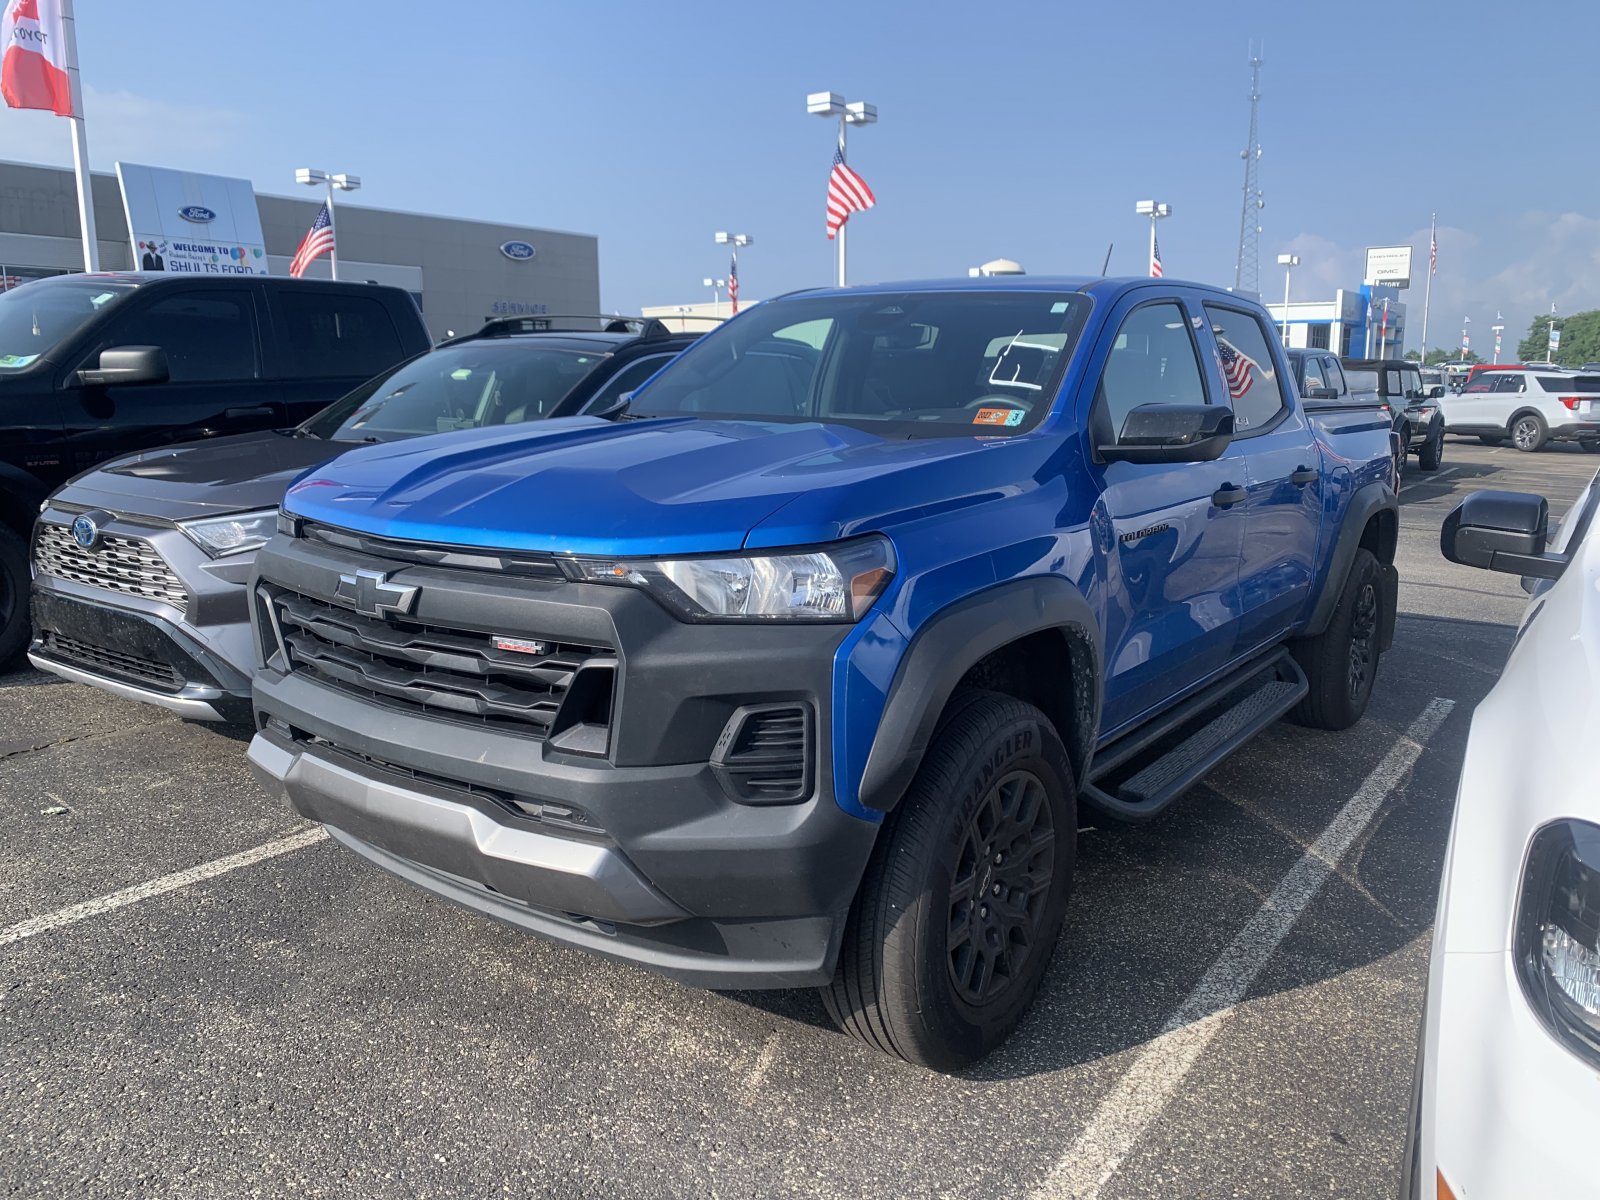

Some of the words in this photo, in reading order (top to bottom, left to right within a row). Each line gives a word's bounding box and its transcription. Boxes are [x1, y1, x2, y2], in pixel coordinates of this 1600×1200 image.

[188, 207, 210, 218] Ford
[173, 243, 216, 254] WELCOME
[217, 246, 229, 255] TO
[509, 244, 529, 257] Ford
[492, 302, 546, 314] SERVICE
[1119, 523, 1169, 543] COLORADO
[951, 730, 1034, 845] WRANGLER
